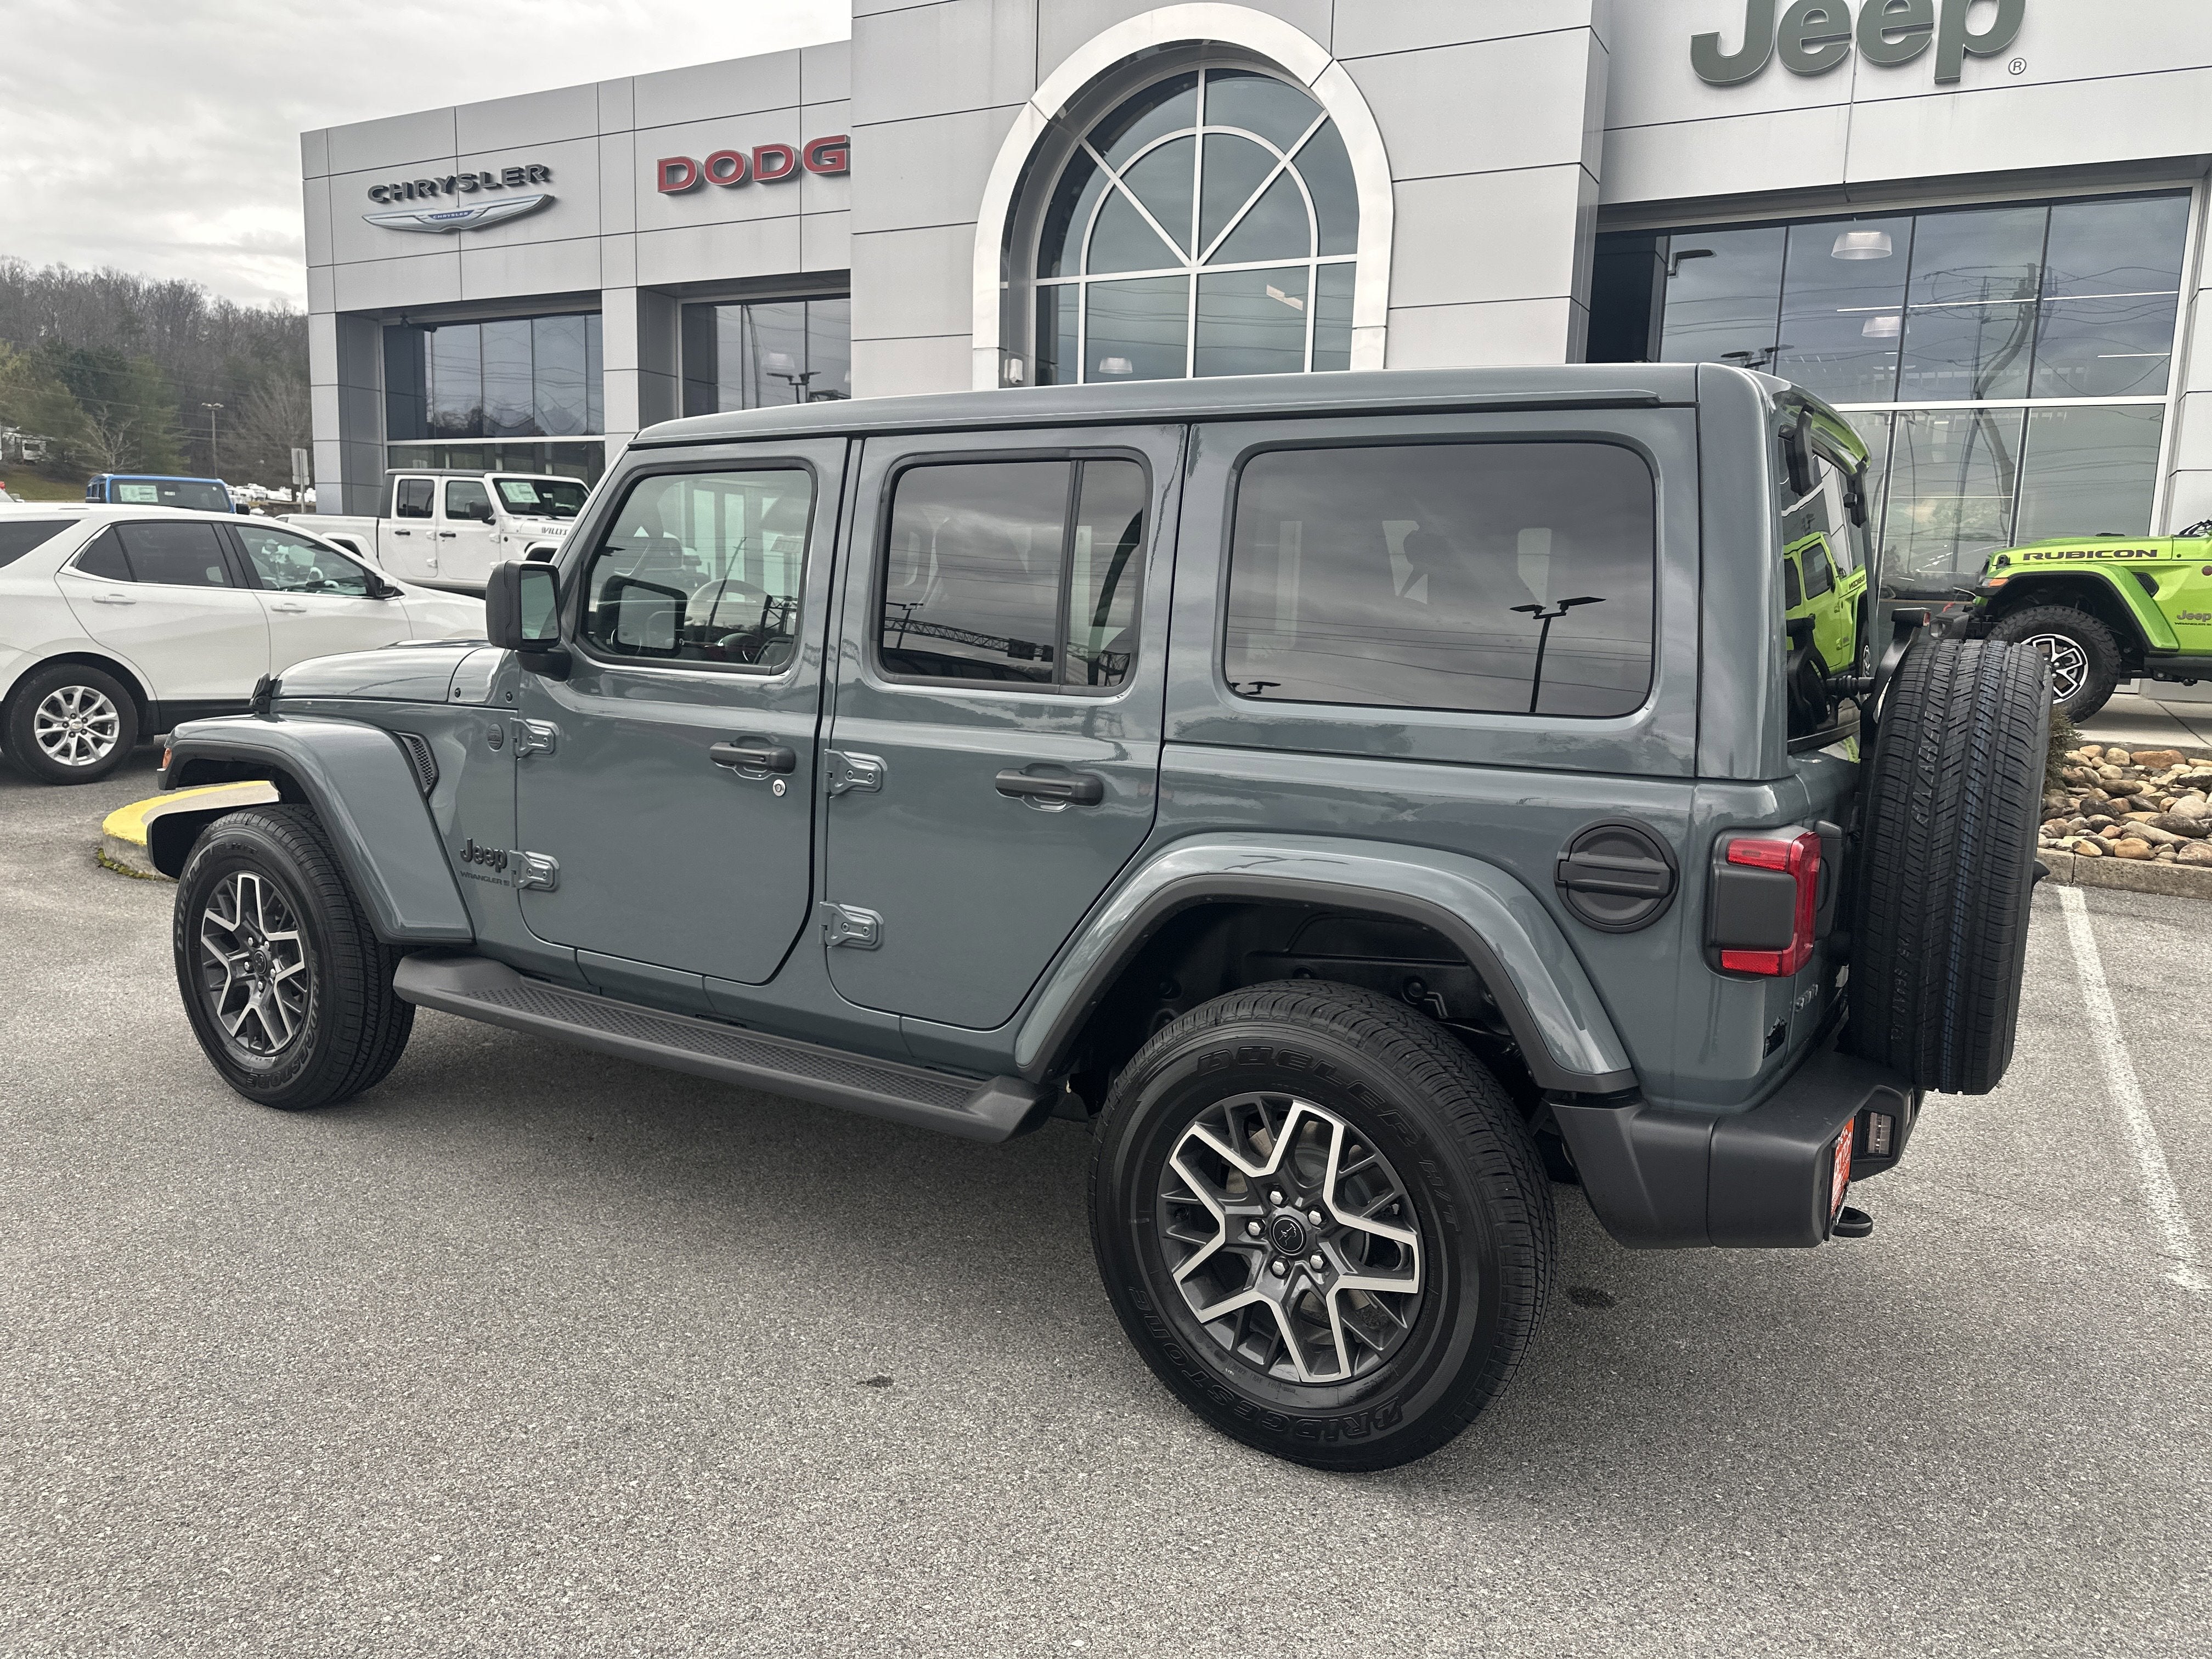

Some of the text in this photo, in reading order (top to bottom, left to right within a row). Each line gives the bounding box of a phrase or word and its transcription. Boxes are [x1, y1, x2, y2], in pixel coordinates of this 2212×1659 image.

[1691, 0, 2025, 84] Jeep
[658, 134, 850, 193] DODG
[368, 163, 550, 202] CHRYSLER
[541, 527, 568, 535] WILLYS
[2023, 549, 2158, 561] RUBICON
[2176, 610, 2211, 622] Jeep
[460, 838, 507, 873] Jeep
[461, 871, 503, 884] WRANGLER
[1197, 1046, 1422, 1148] DUELER
[1126, 1284, 1404, 1443] BRIDGESTONE
